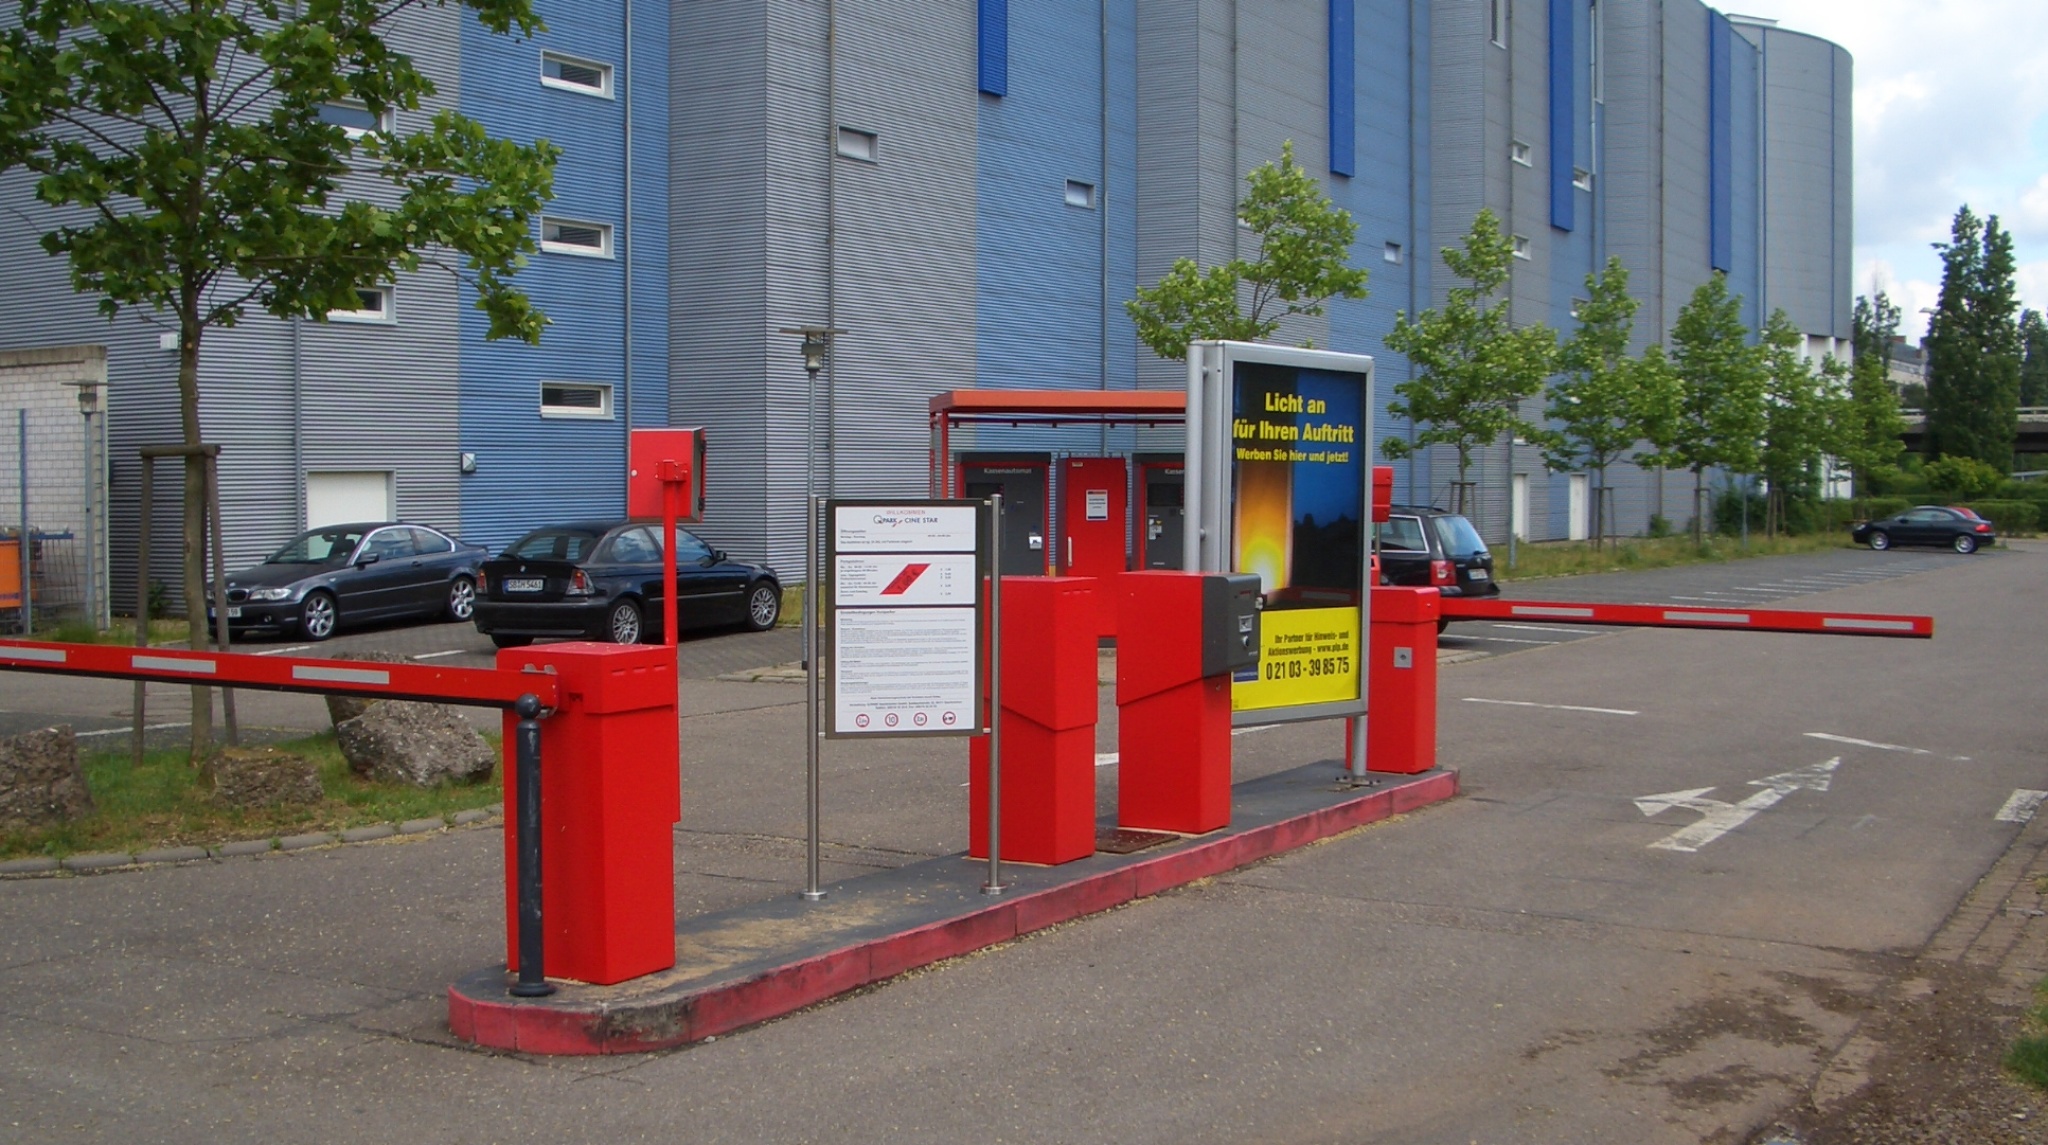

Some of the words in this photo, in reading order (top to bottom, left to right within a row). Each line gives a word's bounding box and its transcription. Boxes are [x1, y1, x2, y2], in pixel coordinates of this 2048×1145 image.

[1265, 392, 1303, 413] Licht
[1307, 398, 1326, 414] an
[1232, 418, 1256, 439] für
[1259, 420, 1299, 441] Ihren
[1302, 422, 1354, 443] Auftritt
[1236, 447, 1272, 460] Werben
[1273, 448, 1288, 461] Sie
[1289, 449, 1307, 461] hier
[1309, 451, 1325, 462] und
[1274, 634, 1283, 644] Ihr
[1284, 634, 1304, 644] Partner
[1314, 630, 1338, 641] Hinweis-
[1338, 630, 1349, 640] und
[1268, 645, 1313, 656] Aktionswerbung
[1266, 662, 1273, 680] 0
[1274, 661, 1286, 680] 21
[1289, 659, 1301, 679] 03
[1309, 658, 1321, 677] 39
[1323, 657, 1335, 676] 85
[1336, 656, 1349, 674] 75
